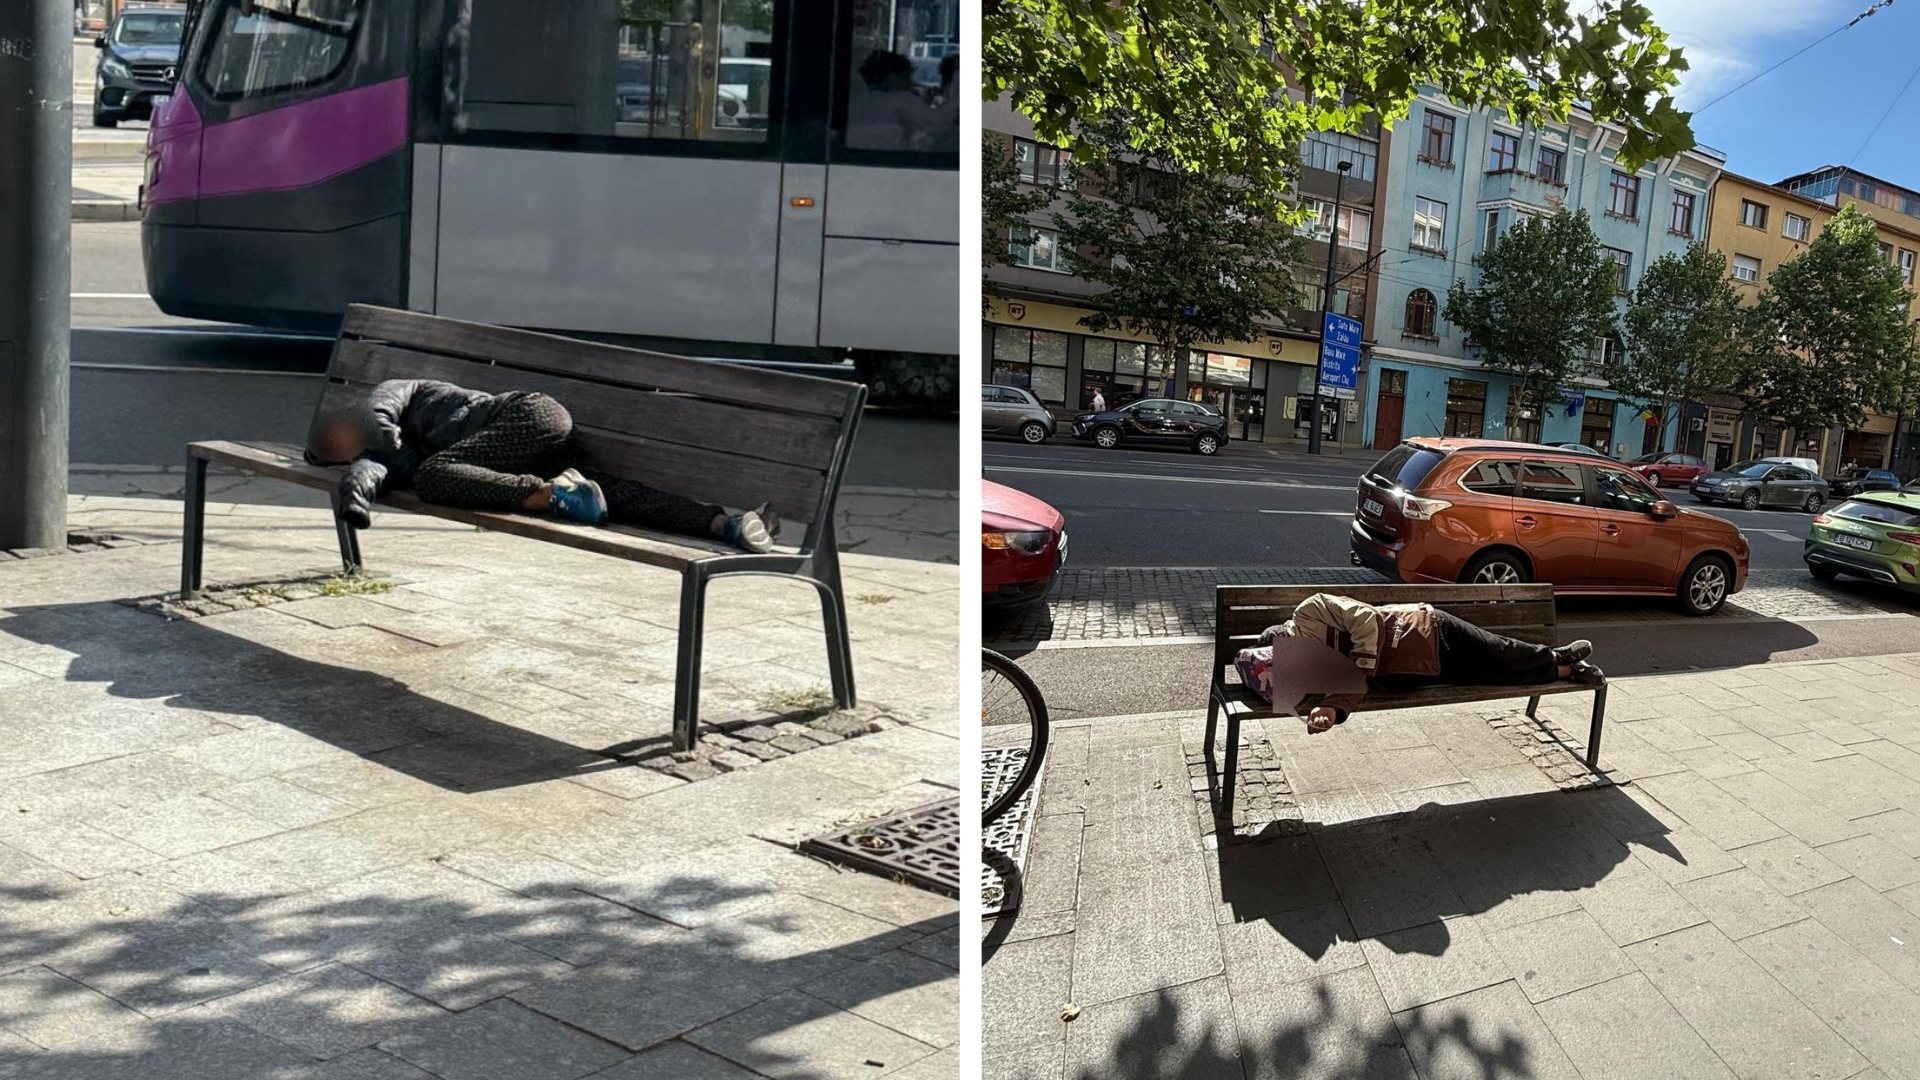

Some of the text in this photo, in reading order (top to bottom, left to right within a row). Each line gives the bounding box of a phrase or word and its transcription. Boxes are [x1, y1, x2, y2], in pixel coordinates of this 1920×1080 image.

[1337, 319, 1359, 334] Satu Mare
[1324, 346, 1346, 360] Baia Mare
[1322, 371, 1349, 386] Aeroport Cluj
